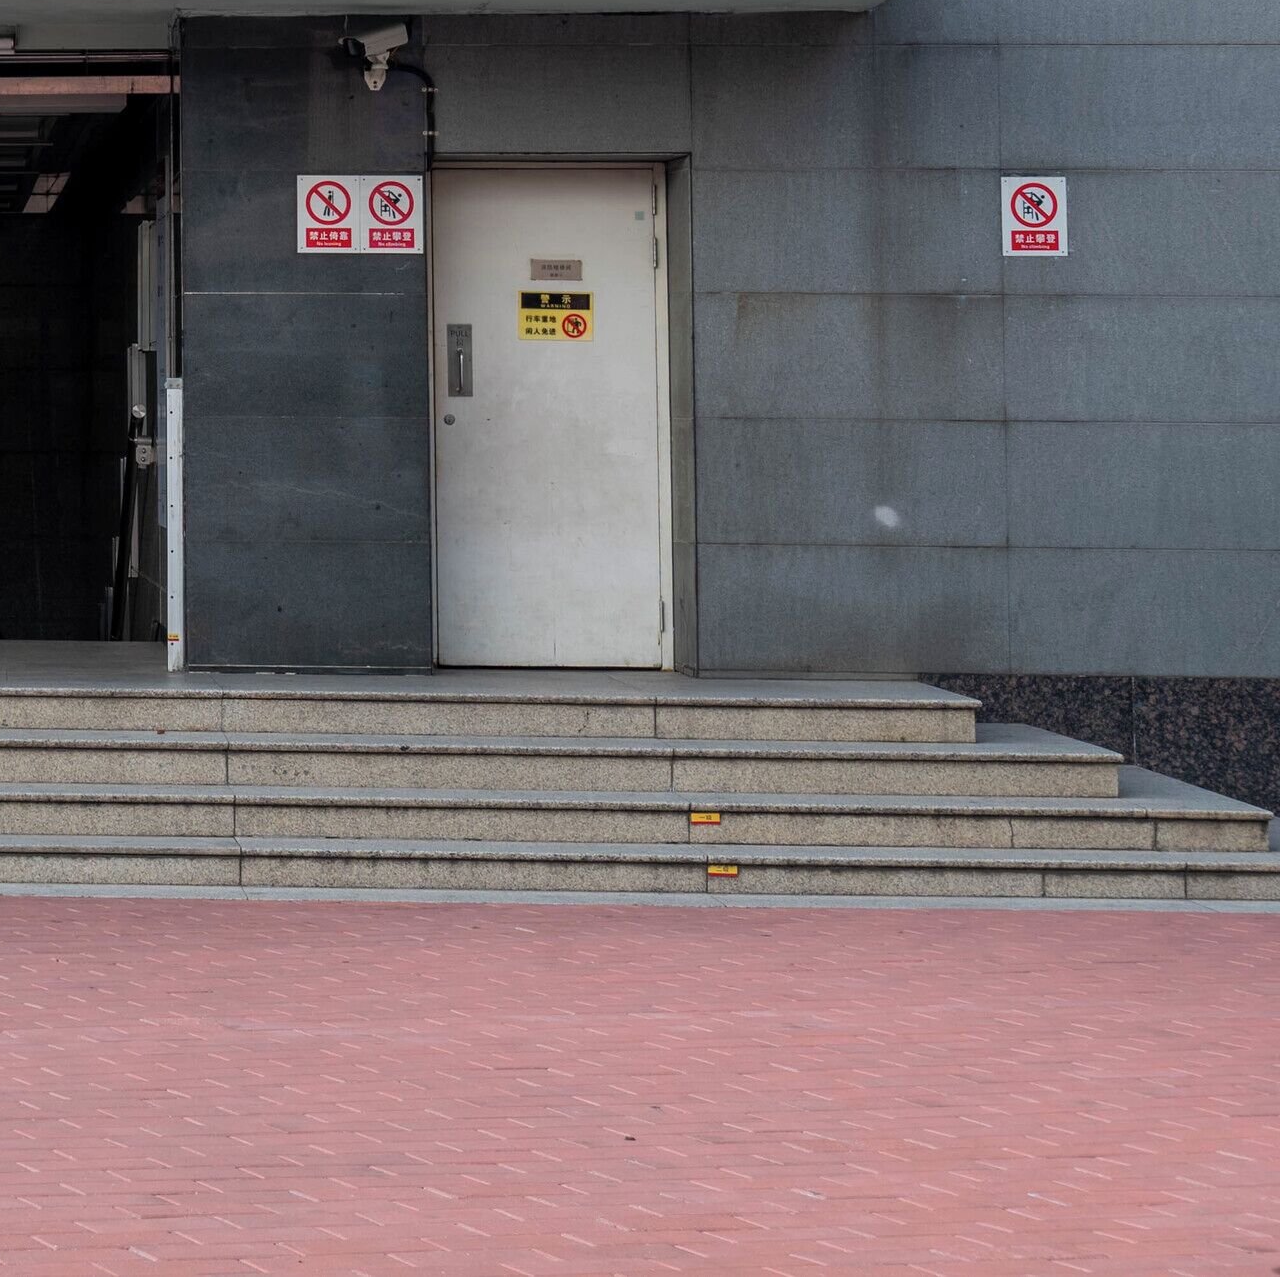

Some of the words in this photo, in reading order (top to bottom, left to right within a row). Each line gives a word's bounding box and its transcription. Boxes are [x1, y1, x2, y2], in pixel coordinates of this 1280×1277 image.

[372, 231, 411, 241] 禁止攀登
[1015, 234, 1056, 244] 禁止攀登
[540, 294, 572, 304] 警示
[525, 315, 557, 324] 行车重地
[525, 327, 557, 336] 闲人免进
